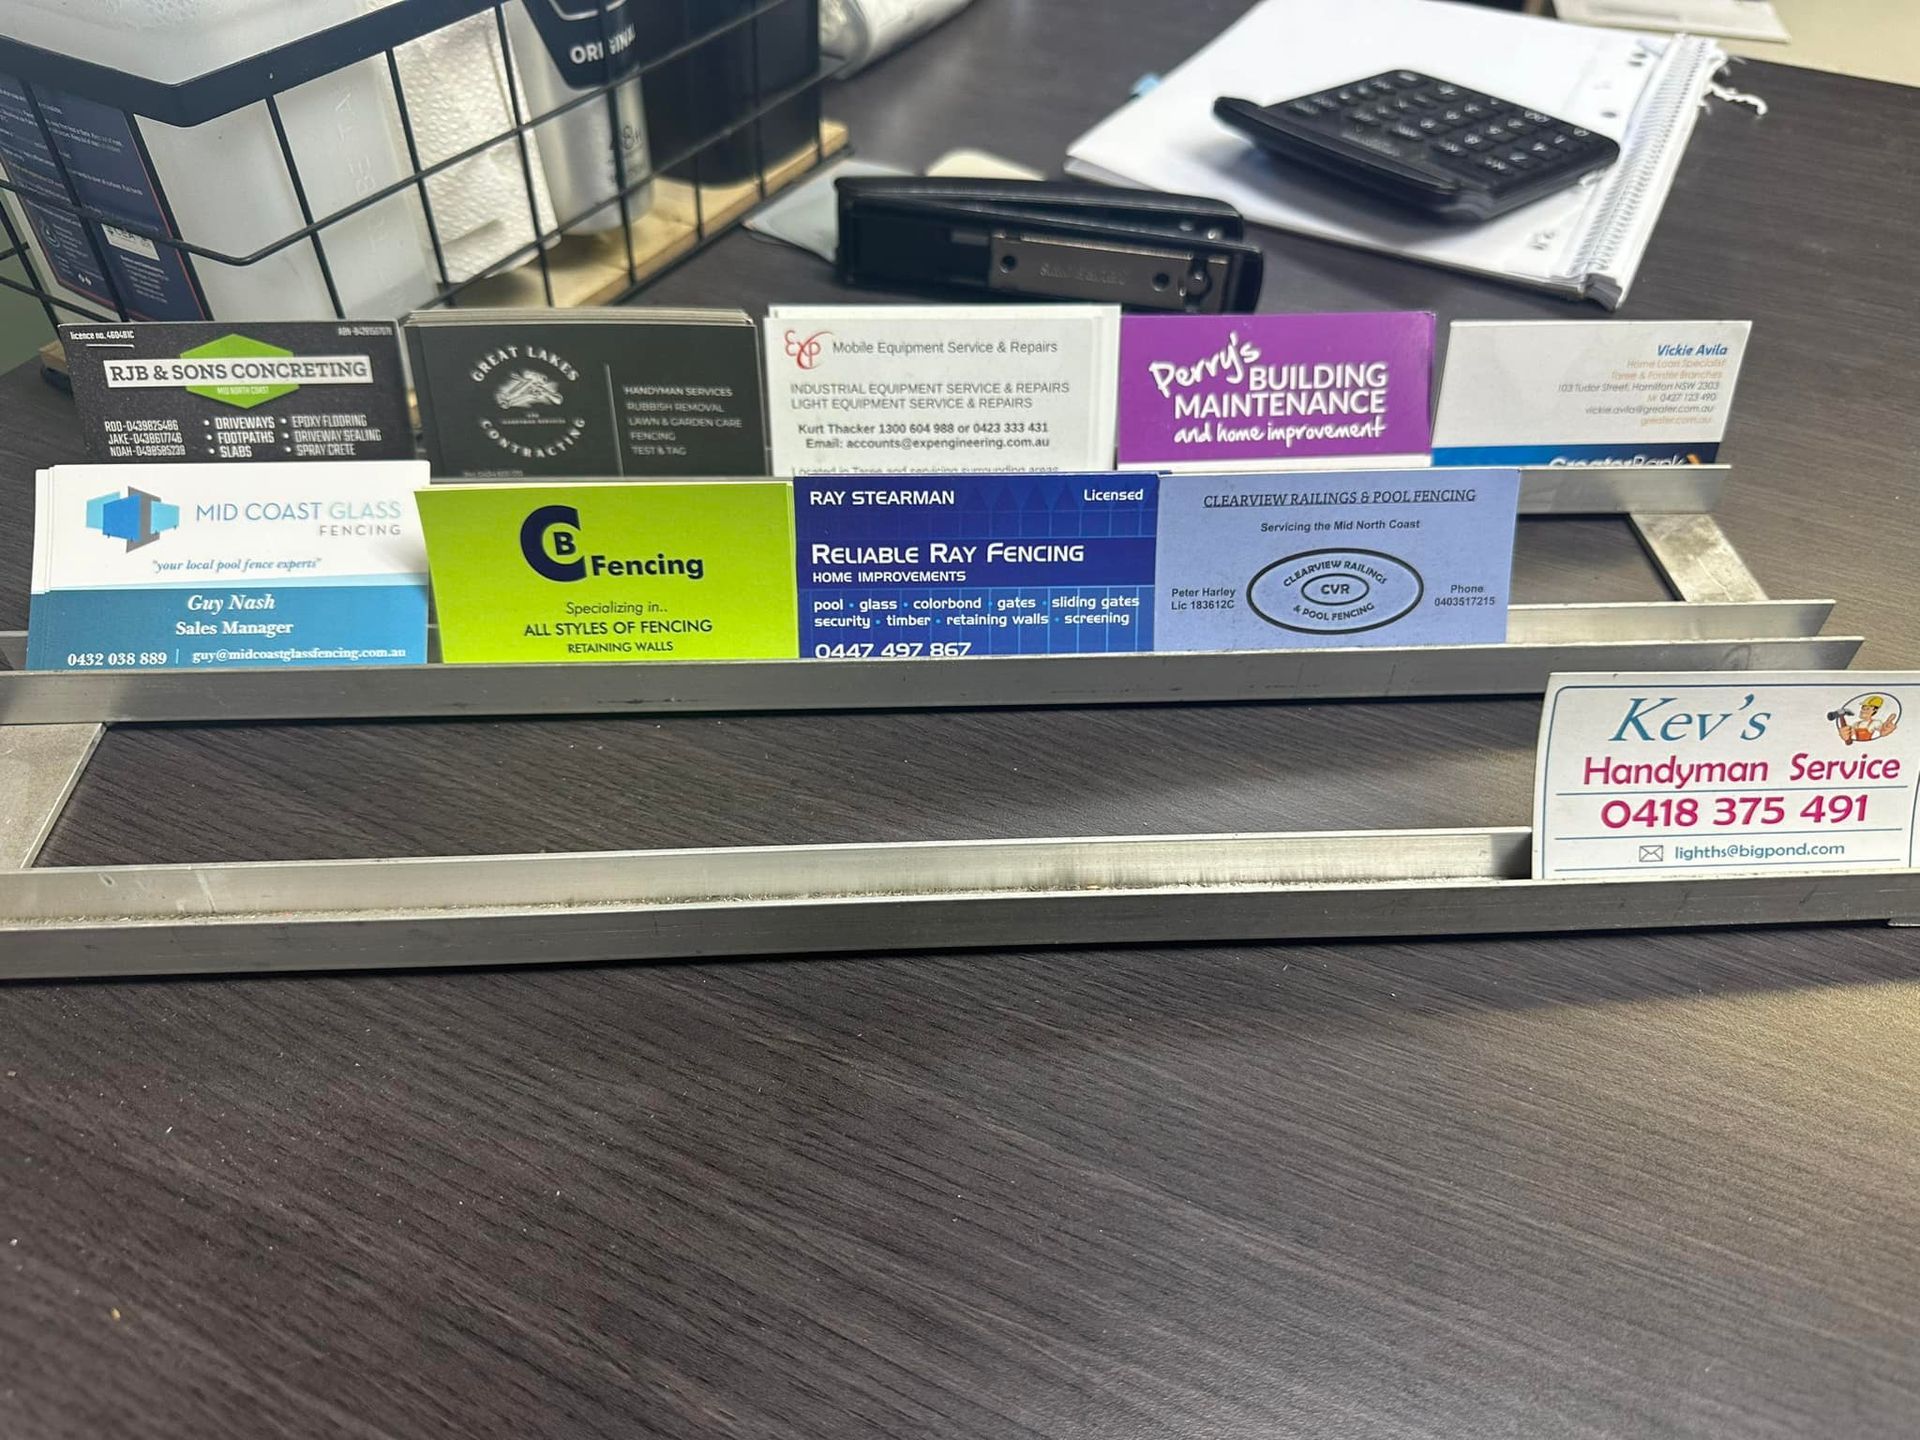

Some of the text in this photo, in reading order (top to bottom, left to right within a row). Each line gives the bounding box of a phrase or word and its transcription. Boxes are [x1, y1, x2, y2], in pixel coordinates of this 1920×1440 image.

[833, 342, 873, 354] Mobile
[878, 342, 944, 356] Equipment
[948, 341, 994, 353] Service
[996, 341, 1006, 353] &
[1010, 340, 1058, 356] Repairs
[1657, 344, 1728, 356] Vickie Avila
[472, 346, 580, 382] GREAT LAKES
[1148, 330, 1262, 398] Perry's
[1680, 358, 1726, 368] Specialist
[110, 361, 368, 381] RJB & SONS CONCRETING
[1250, 362, 1388, 391] BUILDING
[624, 386, 734, 397] HANDYMAN SERVICES
[791, 382, 1070, 396] INDUSTRIAL EQUIPMENT SERVICE & REPAIRS
[1558, 384, 1574, 392] 103
[1575, 384, 1600, 392] Tudor
[1632, 382, 1673, 391] Hamilton
[1674, 382, 1694, 390] NSW
[1696, 382, 1719, 390] 2303
[626, 402, 724, 412] RUBBISH REMOVAL
[792, 398, 1033, 412] LIGHT EQUIPMENT SERVICE & REPAIRS
[1174, 390, 1386, 419] MAINTENANCE
[215, 416, 275, 430] DRIVEWAYS
[292, 414, 368, 428] EPOXY FLOORING
[628, 417, 743, 428] LAWN GARDEN CARE
[798, 422, 1048, 434] Kurt Thacker 1300 604 988 or 0423 333 431
[217, 430, 275, 444] FOOTPATHS
[294, 429, 382, 442] DRIVEWAY SEALING
[481, 418, 586, 459] CONTRACTING
[630, 432, 676, 441] FENCING
[1174, 416, 1387, 448] and home improvement
[296, 444, 356, 456] SPRAY CRETE
[632, 446, 687, 456] TEST TAG
[806, 438, 1050, 450] Email: accounts@expengineering.com.au
[220, 446, 252, 458] SLABS
[810, 490, 954, 505] RAY STEARMAN
[1084, 488, 1144, 502] Licensed
[1203, 488, 1476, 508] CLEARVIEW RAILINGS & POOL FENCING
[196, 500, 402, 522] MID COAST GLASS
[319, 524, 401, 536] FENCING
[1260, 518, 1420, 534] Servicing the Mid North Coast
[812, 542, 1084, 564] RELIABLE RAY FENCING
[186, 558, 214, 570] local
[216, 558, 242, 572] pool
[243, 558, 273, 573] fence
[591, 554, 704, 580] Fencing
[812, 571, 966, 583] HOME IMPROVEMENTS
[1283, 560, 1388, 587] CLEARVIEW RAILINGS
[1172, 586, 1236, 598] Peter Harley
[1320, 584, 1350, 594] CVR
[1450, 584, 1484, 594] Phone
[187, 594, 276, 613] Guy Nash
[814, 596, 1140, 612] pool glass colorbond gates sliding gates
[1171, 600, 1235, 610] Lic 183612C
[1434, 596, 1496, 607] 0403517215
[566, 602, 644, 616] Specializing
[1293, 602, 1375, 621] & POOL FENCING
[814, 612, 1129, 629] security timber retaining walls screening
[176, 620, 294, 640] Sales Manager
[524, 619, 712, 637] ALL STYLES OF FENCING
[192, 646, 406, 662] guy@midcoastglassfencing.com.au
[567, 641, 674, 654] RETAINING WALLS
[815, 642, 972, 658] 0447 497 867
[68, 652, 167, 666] 0432 038 889
[1608, 694, 1772, 742] Kev's
[1583, 752, 1901, 790] Handyman Service
[1601, 794, 1869, 829] 0418 375 491
[1675, 843, 1845, 861] lighths@bigpond.com
